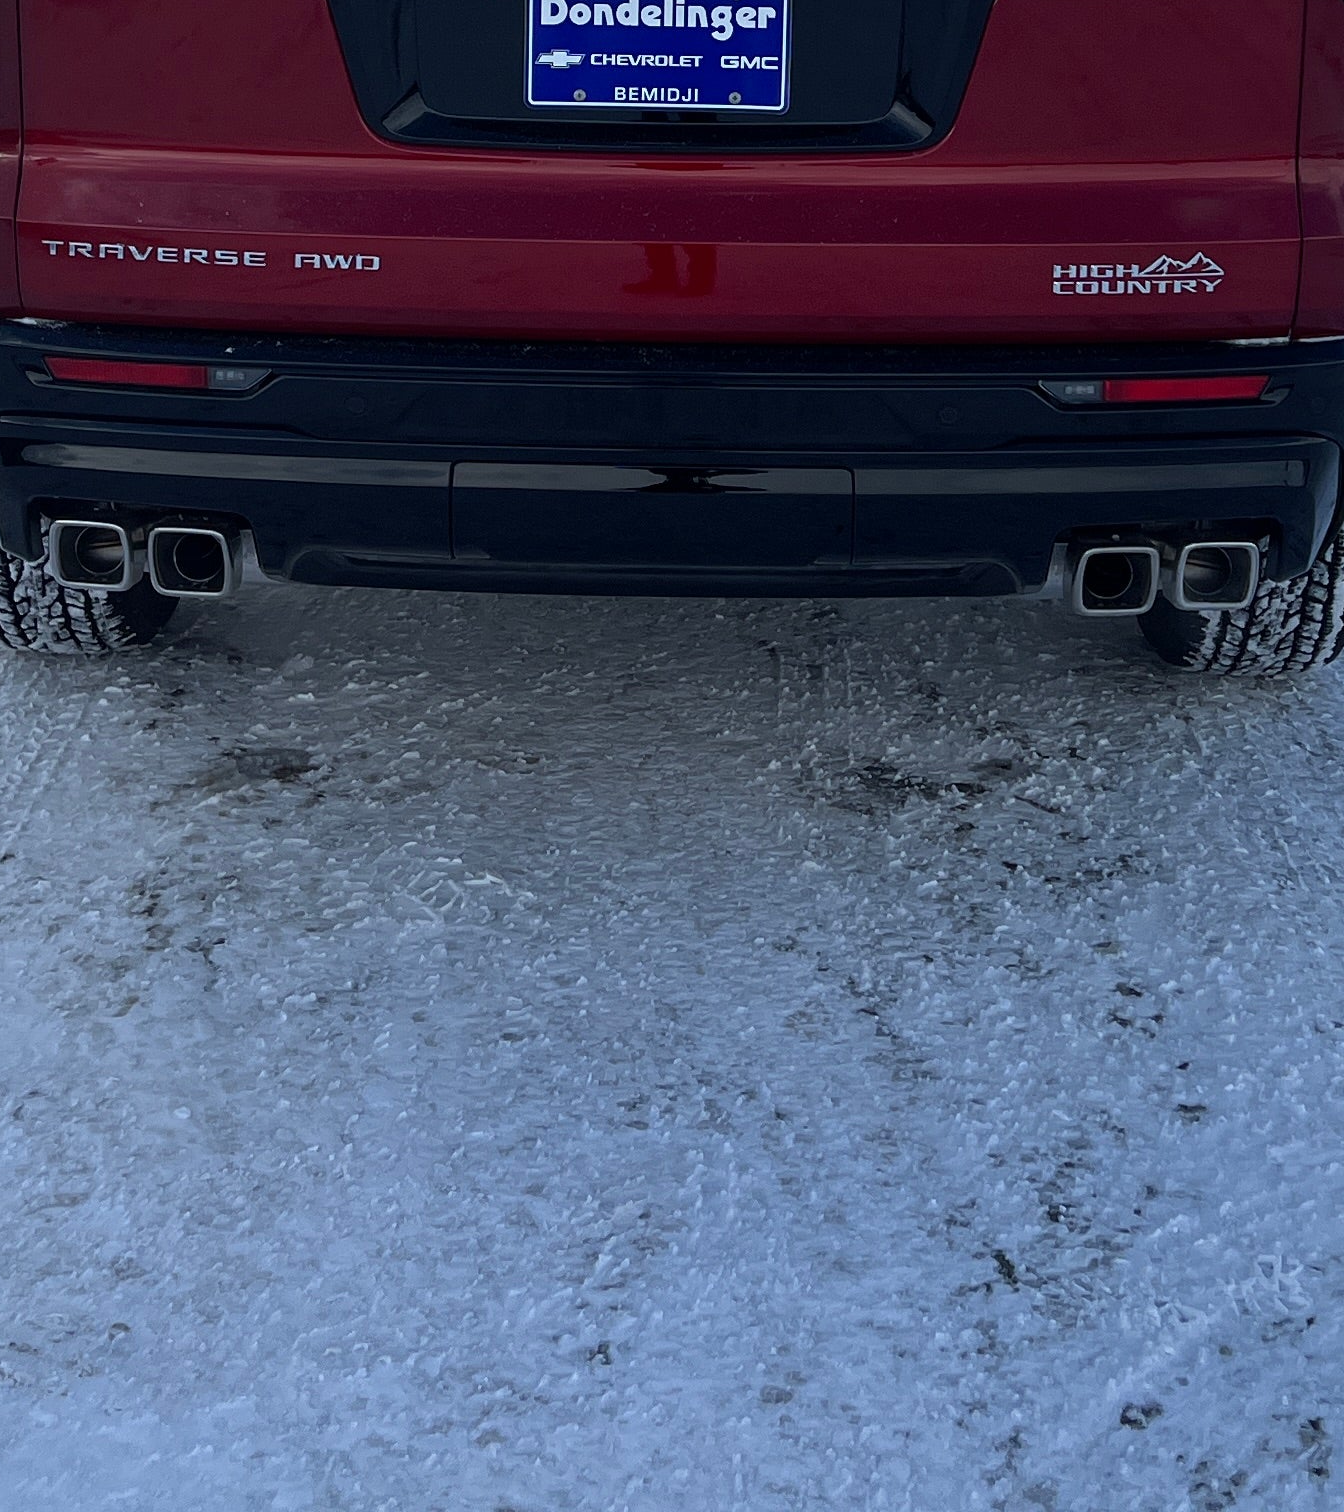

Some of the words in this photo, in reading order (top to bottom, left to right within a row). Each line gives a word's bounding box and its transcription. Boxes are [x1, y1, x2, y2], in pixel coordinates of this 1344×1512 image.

[590, 53, 704, 68] CHEVROLET
[720, 55, 779, 70] GMC
[614, 86, 699, 103] BEMIDJI
[41, 239, 267, 268] TRAVERSE
[294, 252, 381, 271] AWD
[1052, 263, 1140, 279] HIGH
[1052, 278, 1223, 295] COUNTRY
